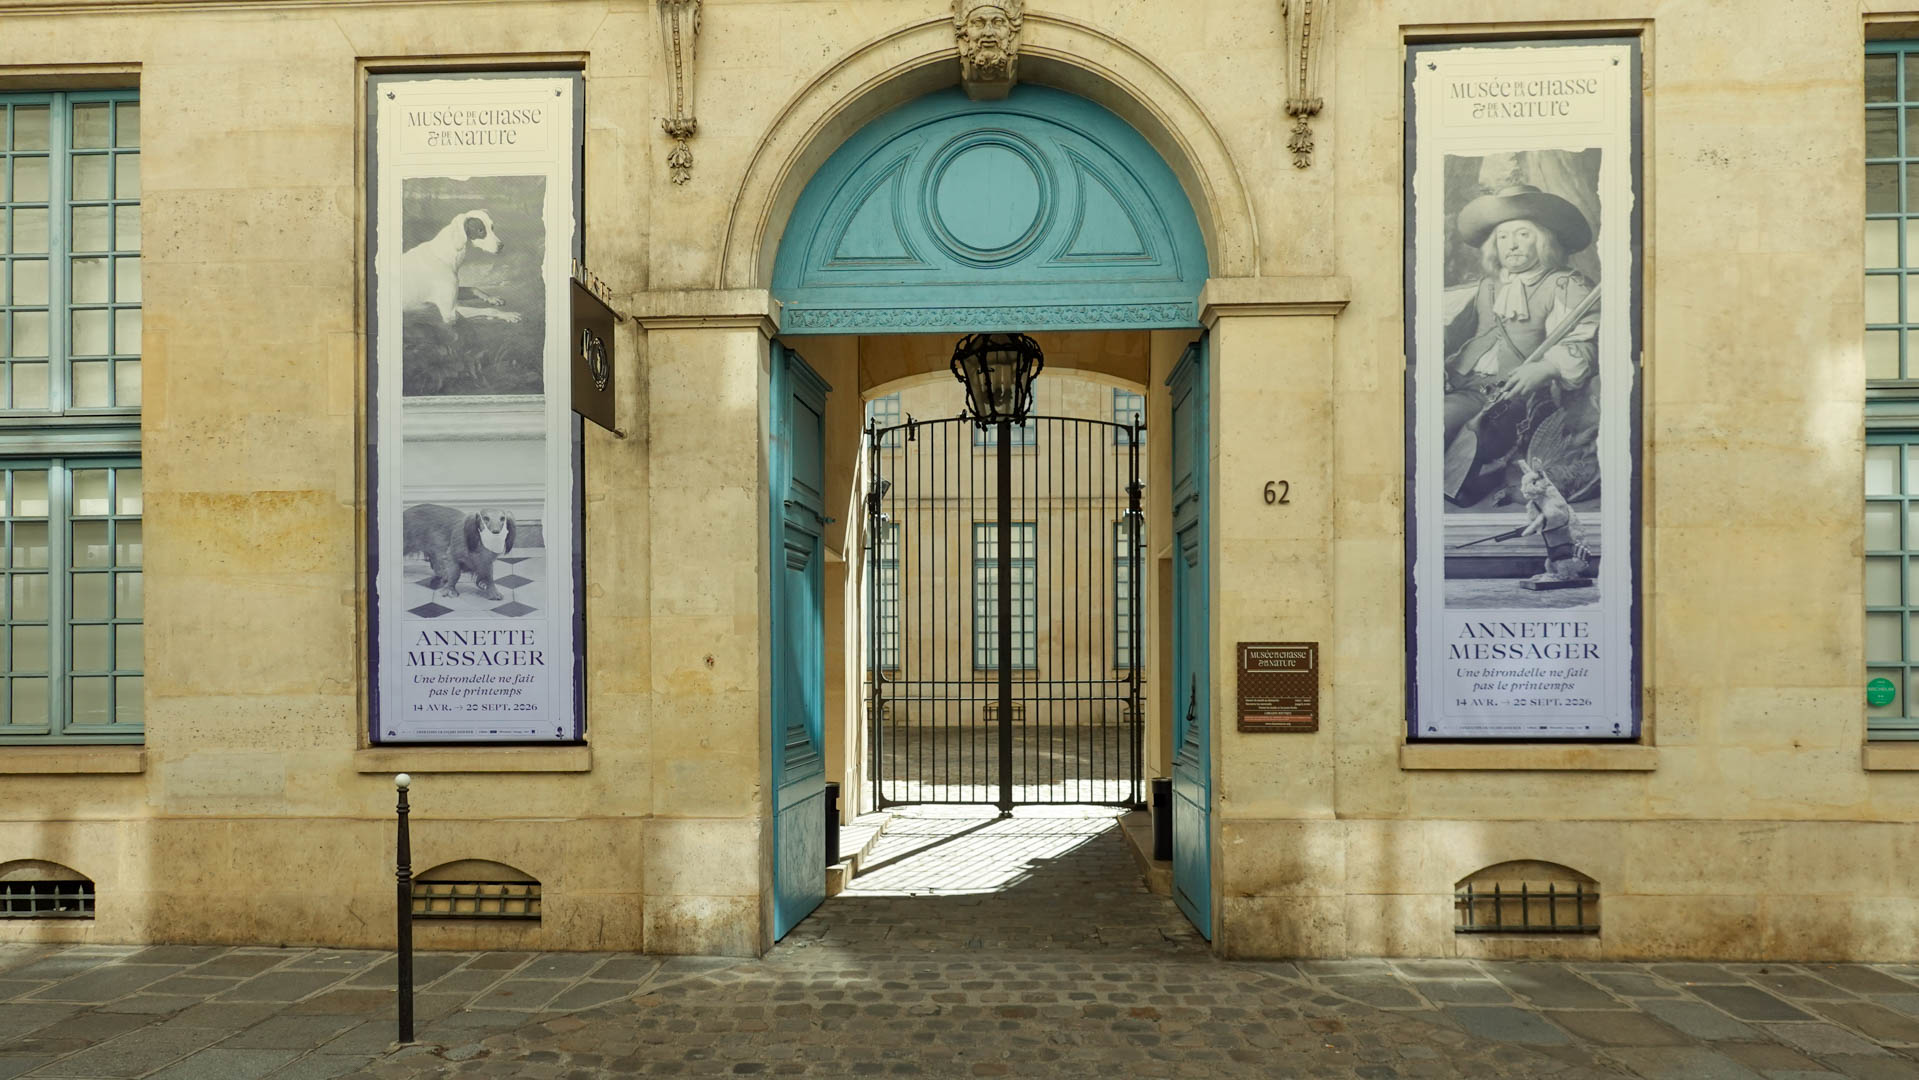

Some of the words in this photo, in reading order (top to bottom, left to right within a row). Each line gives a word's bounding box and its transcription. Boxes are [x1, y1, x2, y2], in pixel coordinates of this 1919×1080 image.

[1472, 103, 1486, 119] &
[427, 131, 440, 147] &
[1264, 480, 1290, 505] 62
[416, 629, 535, 646] ANNETTE
[1458, 622, 1590, 639] ANNETTE
[406, 650, 545, 667] MESSAGER
[1448, 643, 1601, 660] MESSAGER
[413, 674, 435, 684] Une
[437, 674, 496, 684] hirondelle
[498, 676, 512, 684] ne
[512, 674, 535, 685] fait
[1456, 668, 1480, 677] Une
[1482, 667, 1547, 677] hirondelle
[1563, 667, 1588, 679] fait
[429, 688, 449, 698] pas
[451, 687, 462, 696] le
[463, 686, 522, 698] printemps
[1472, 682, 1494, 692] pas
[1497, 681, 1508, 690] le
[1510, 680, 1575, 692] printemps
[413, 704, 423, 712] 14
[426, 704, 452, 712] AVR.
[513, 703, 538, 711] 2026
[1456, 698, 1467, 706] 14
[1470, 698, 1498, 706] AVR.
[1513, 698, 1526, 706] 20
[1530, 698, 1563, 706] SEPT.
[1565, 698, 1592, 706] 2026
